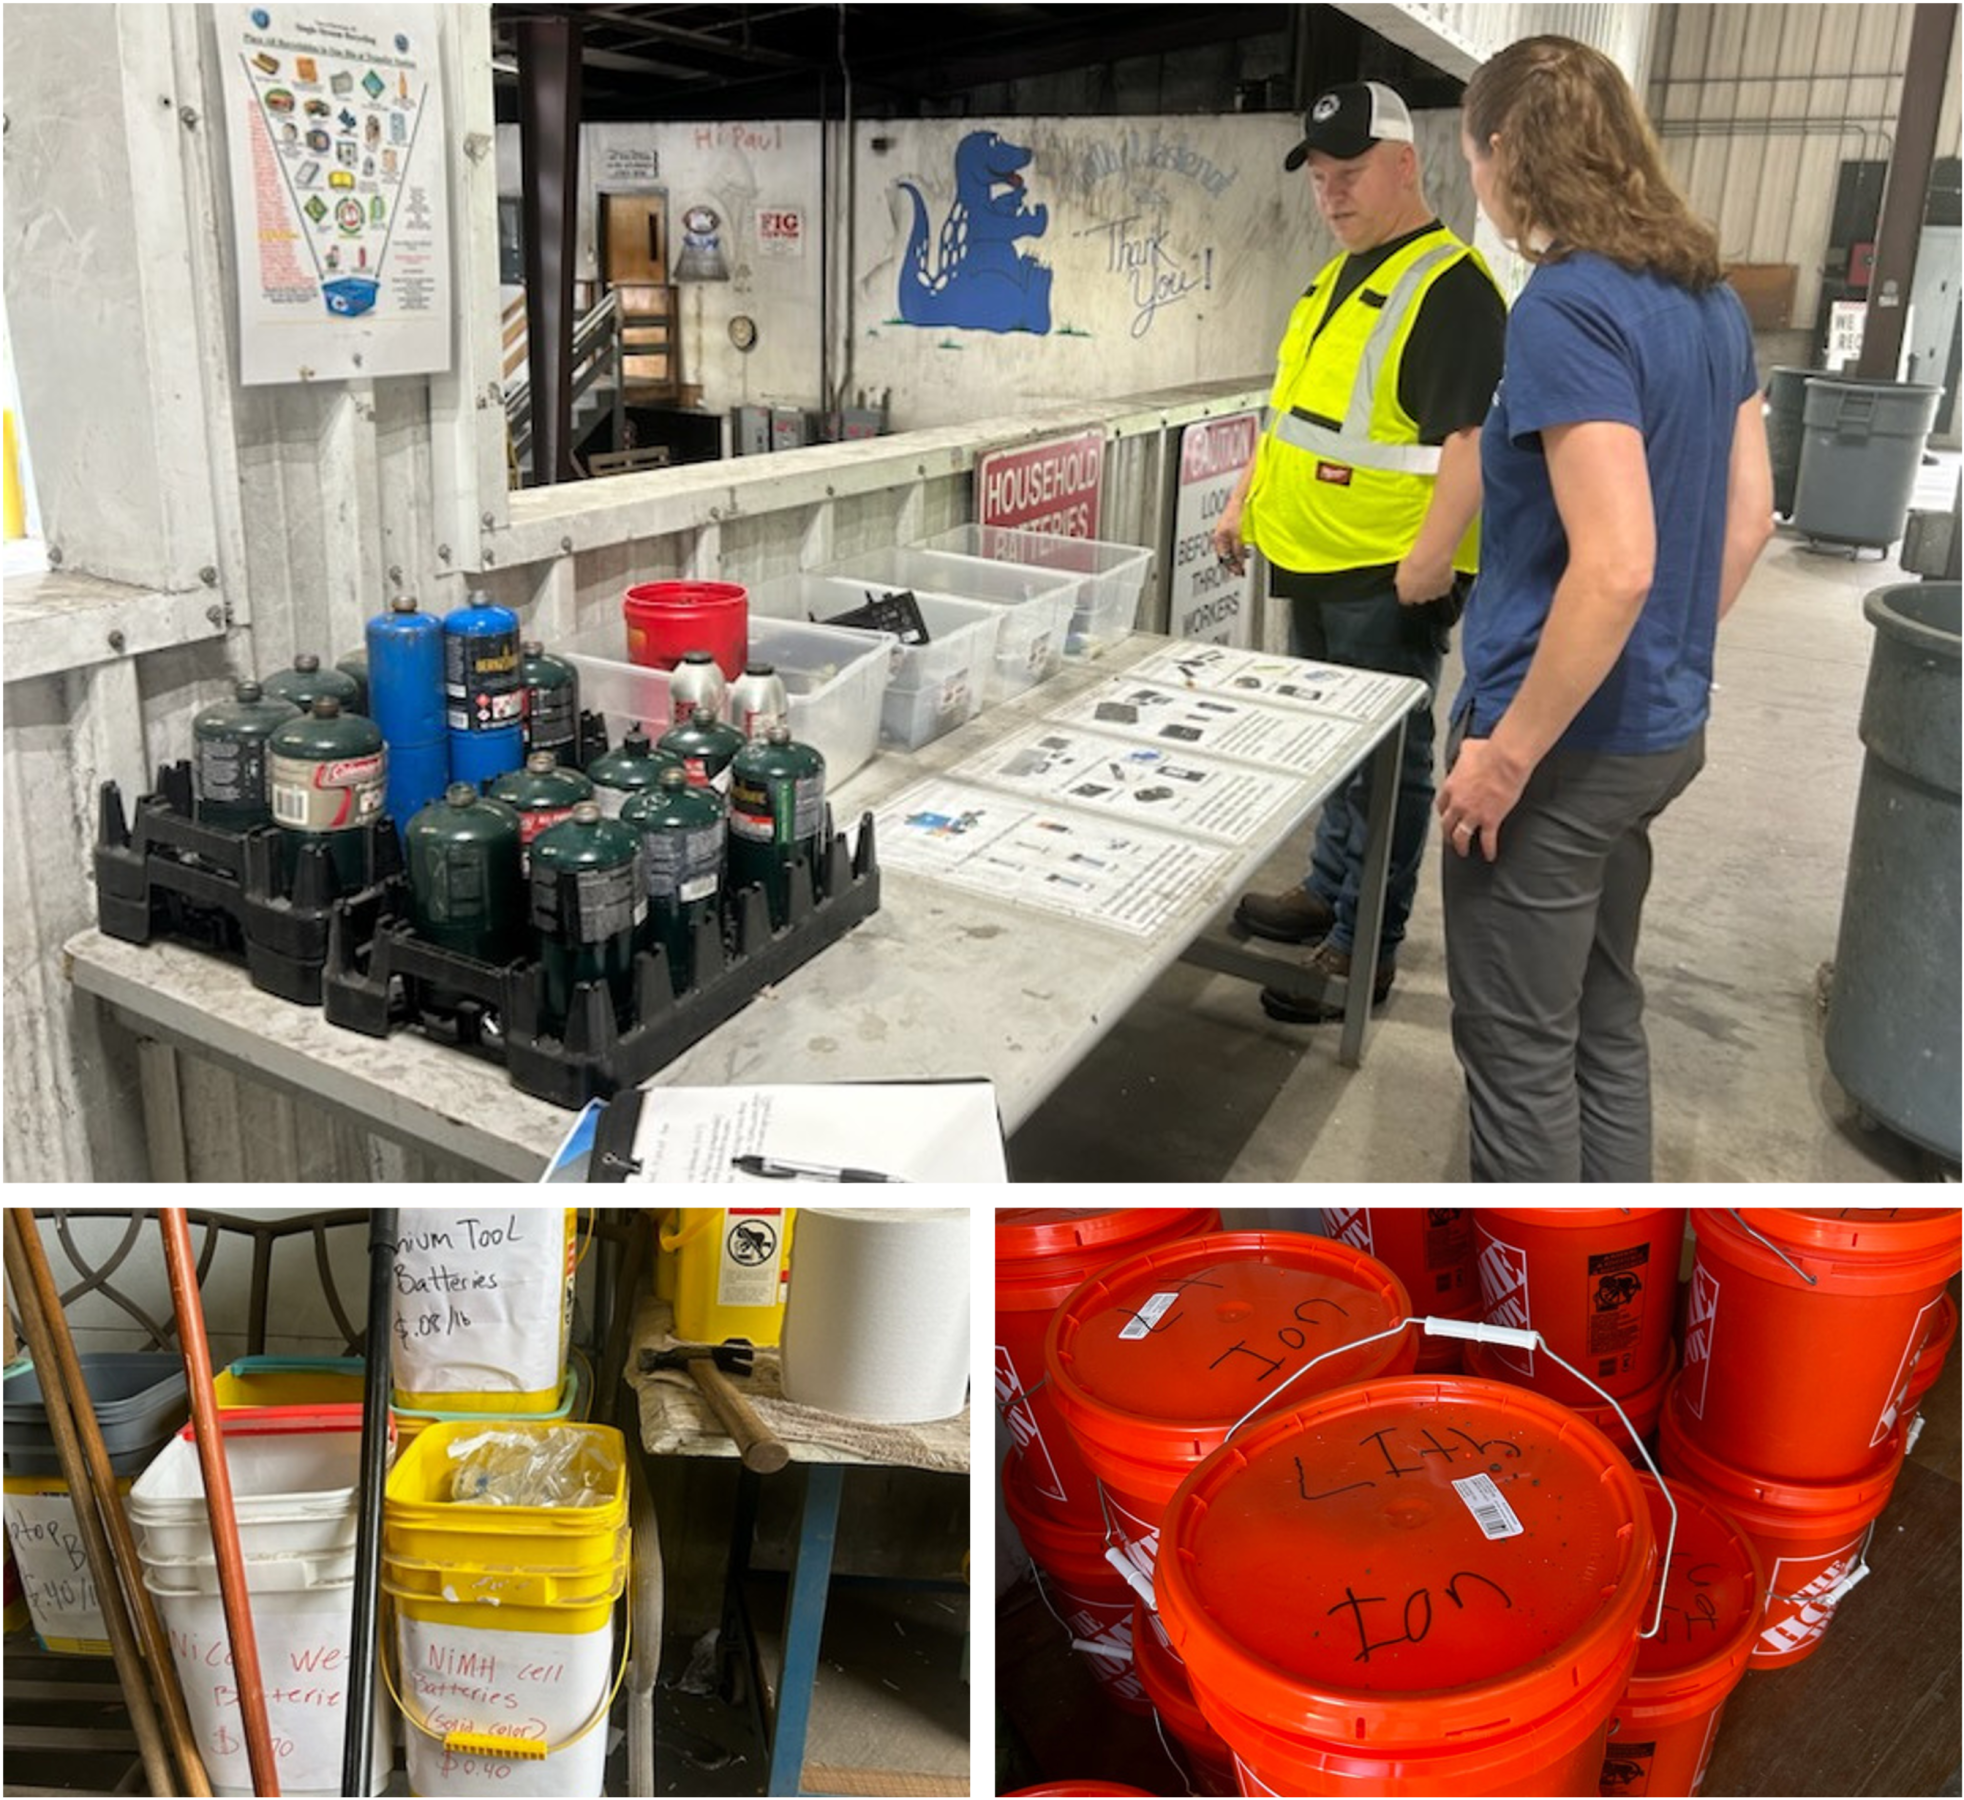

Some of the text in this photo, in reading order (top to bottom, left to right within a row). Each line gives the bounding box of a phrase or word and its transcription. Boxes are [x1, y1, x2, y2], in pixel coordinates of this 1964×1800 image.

[694, 124, 783, 150] Hi Paul
[759, 212, 799, 232] FIG
[986, 448, 1098, 519] HOUSEHOLD
[1201, 486, 1232, 520] LOO
[994, 503, 1090, 561] BATTERIES
[393, 1263, 498, 1296] Batteries
[1208, 1298, 1350, 1383] Ion
[1327, 1571, 1513, 1664] Ion
[290, 1646, 351, 1674] We
[429, 1644, 565, 1684] NiMH cell
[411, 1668, 520, 1710] Batteries
